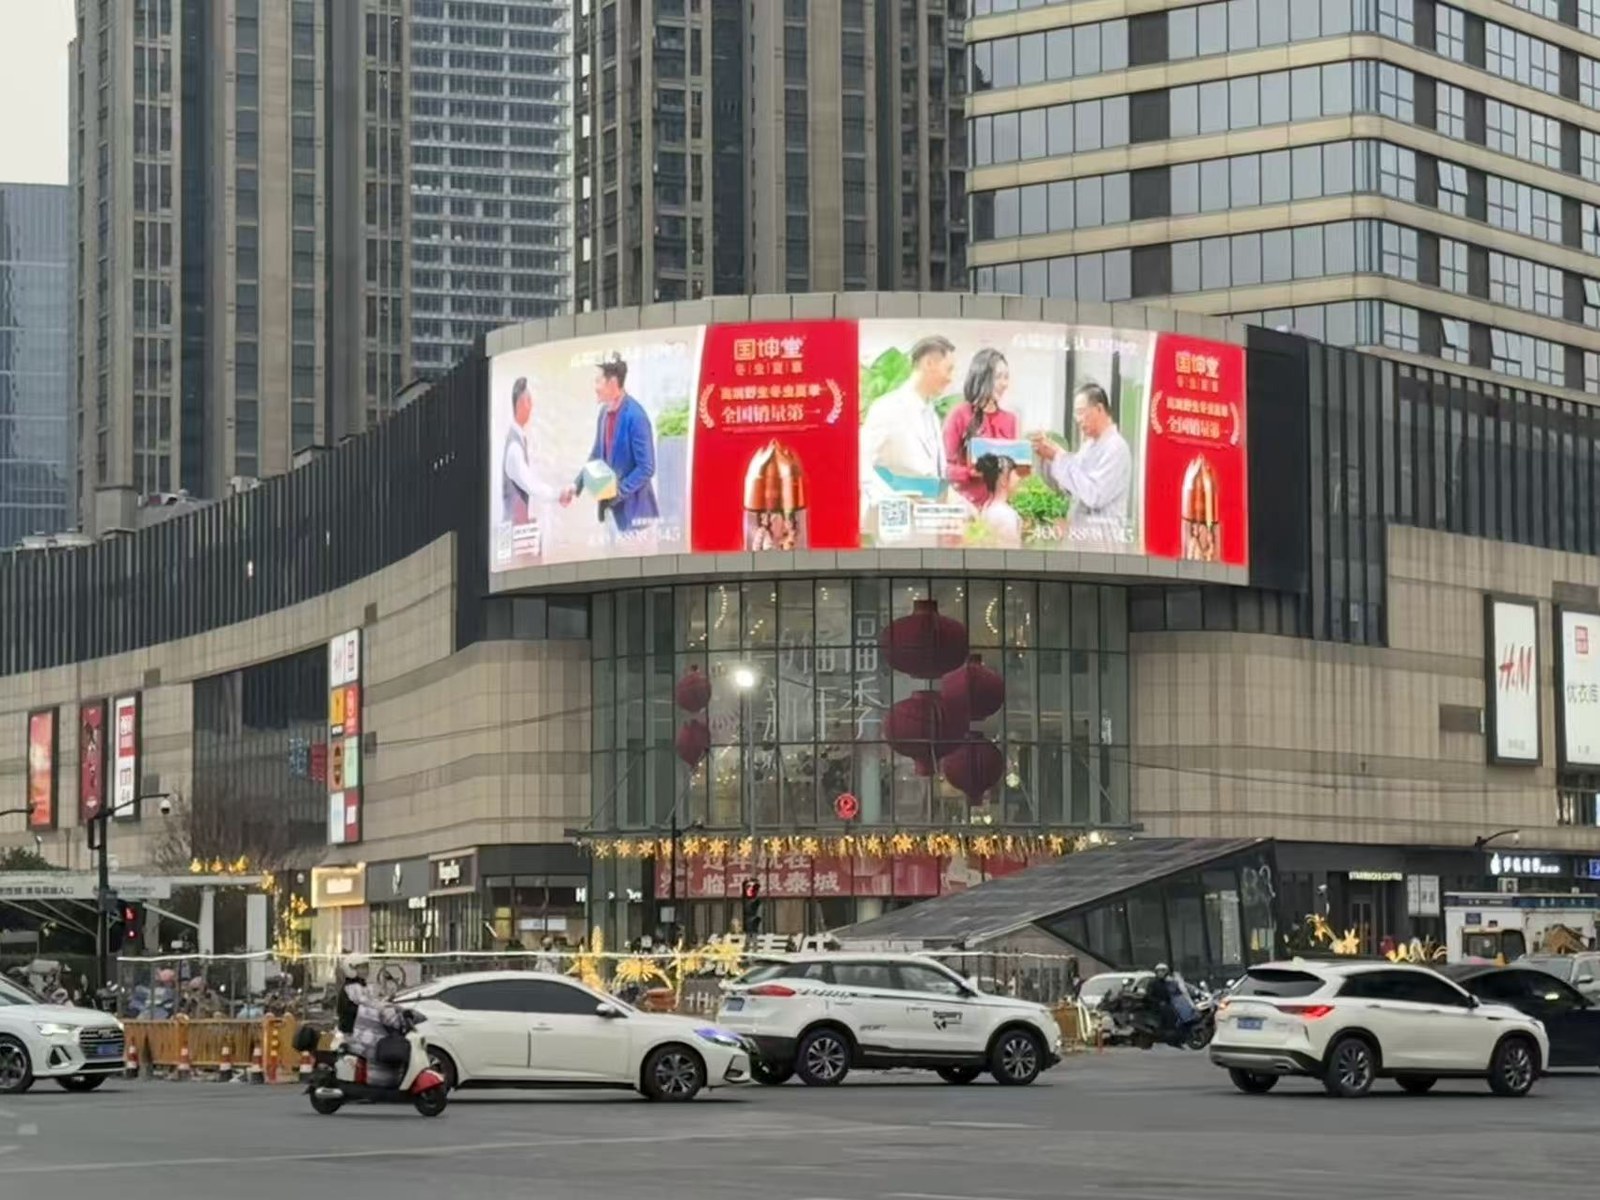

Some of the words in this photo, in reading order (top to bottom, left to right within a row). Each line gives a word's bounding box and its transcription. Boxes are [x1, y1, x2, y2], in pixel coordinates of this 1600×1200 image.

[734, 336, 804, 361] 国坤堂
[721, 403, 821, 424] 全国销量第一
